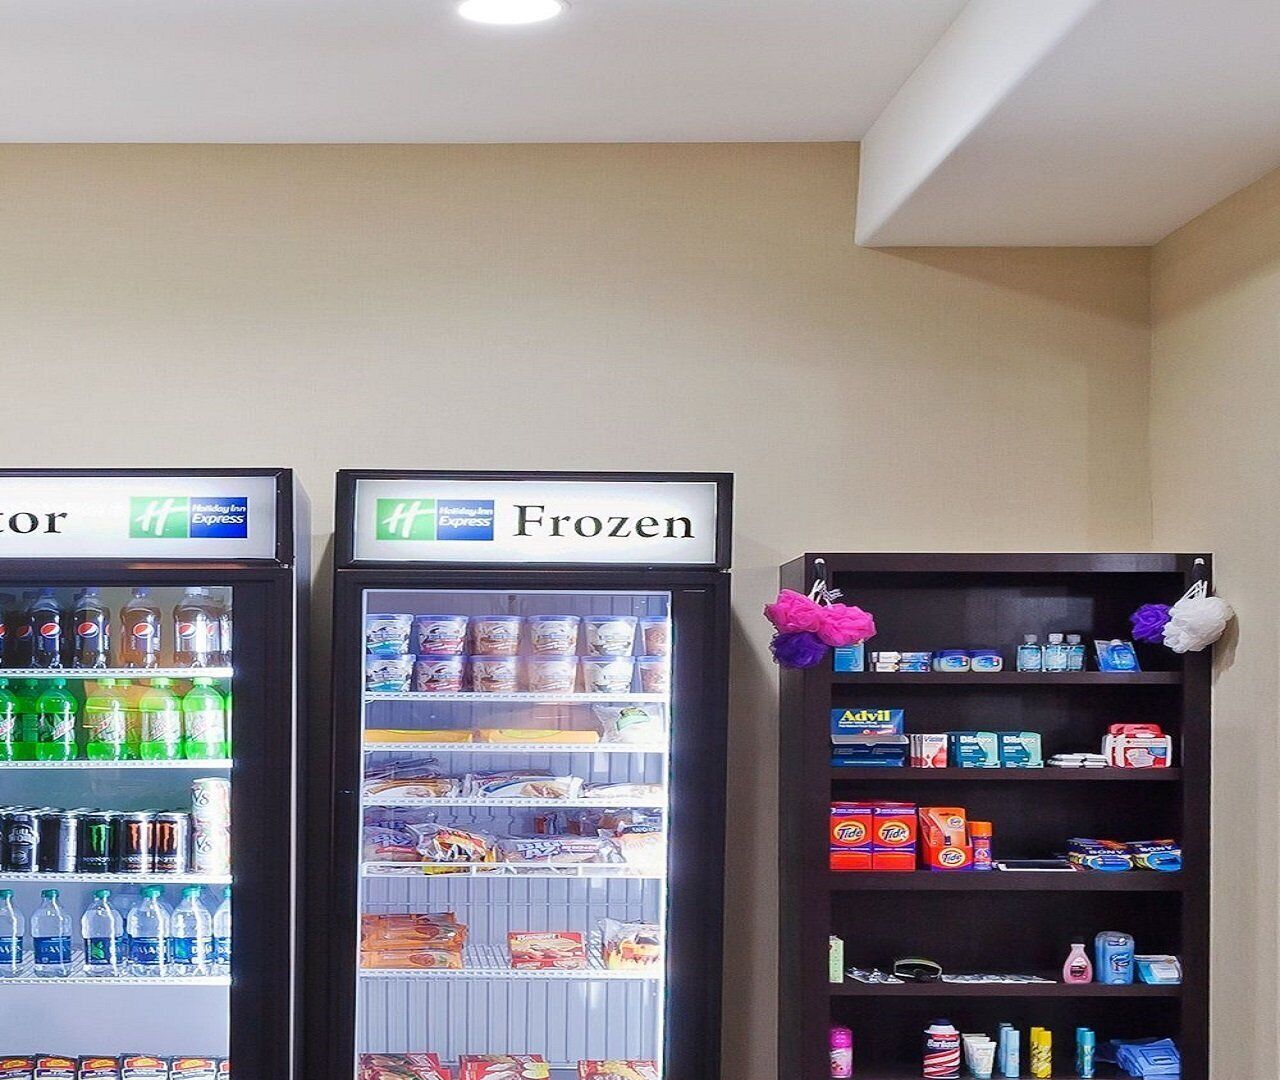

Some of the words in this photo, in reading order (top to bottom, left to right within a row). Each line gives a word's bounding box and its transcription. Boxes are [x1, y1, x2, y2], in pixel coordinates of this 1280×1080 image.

[191, 503, 229, 514] Holiday
[231, 504, 246, 512] Inn
[439, 506, 477, 517] Holiday
[478, 506, 493, 515] Inn
[192, 513, 245, 525] Express
[439, 516, 491, 528] Express
[513, 504, 695, 539] Frozen
[840, 710, 891, 722] Advil
[838, 827, 863, 840] Tide
[941, 851, 962, 863] Tide
